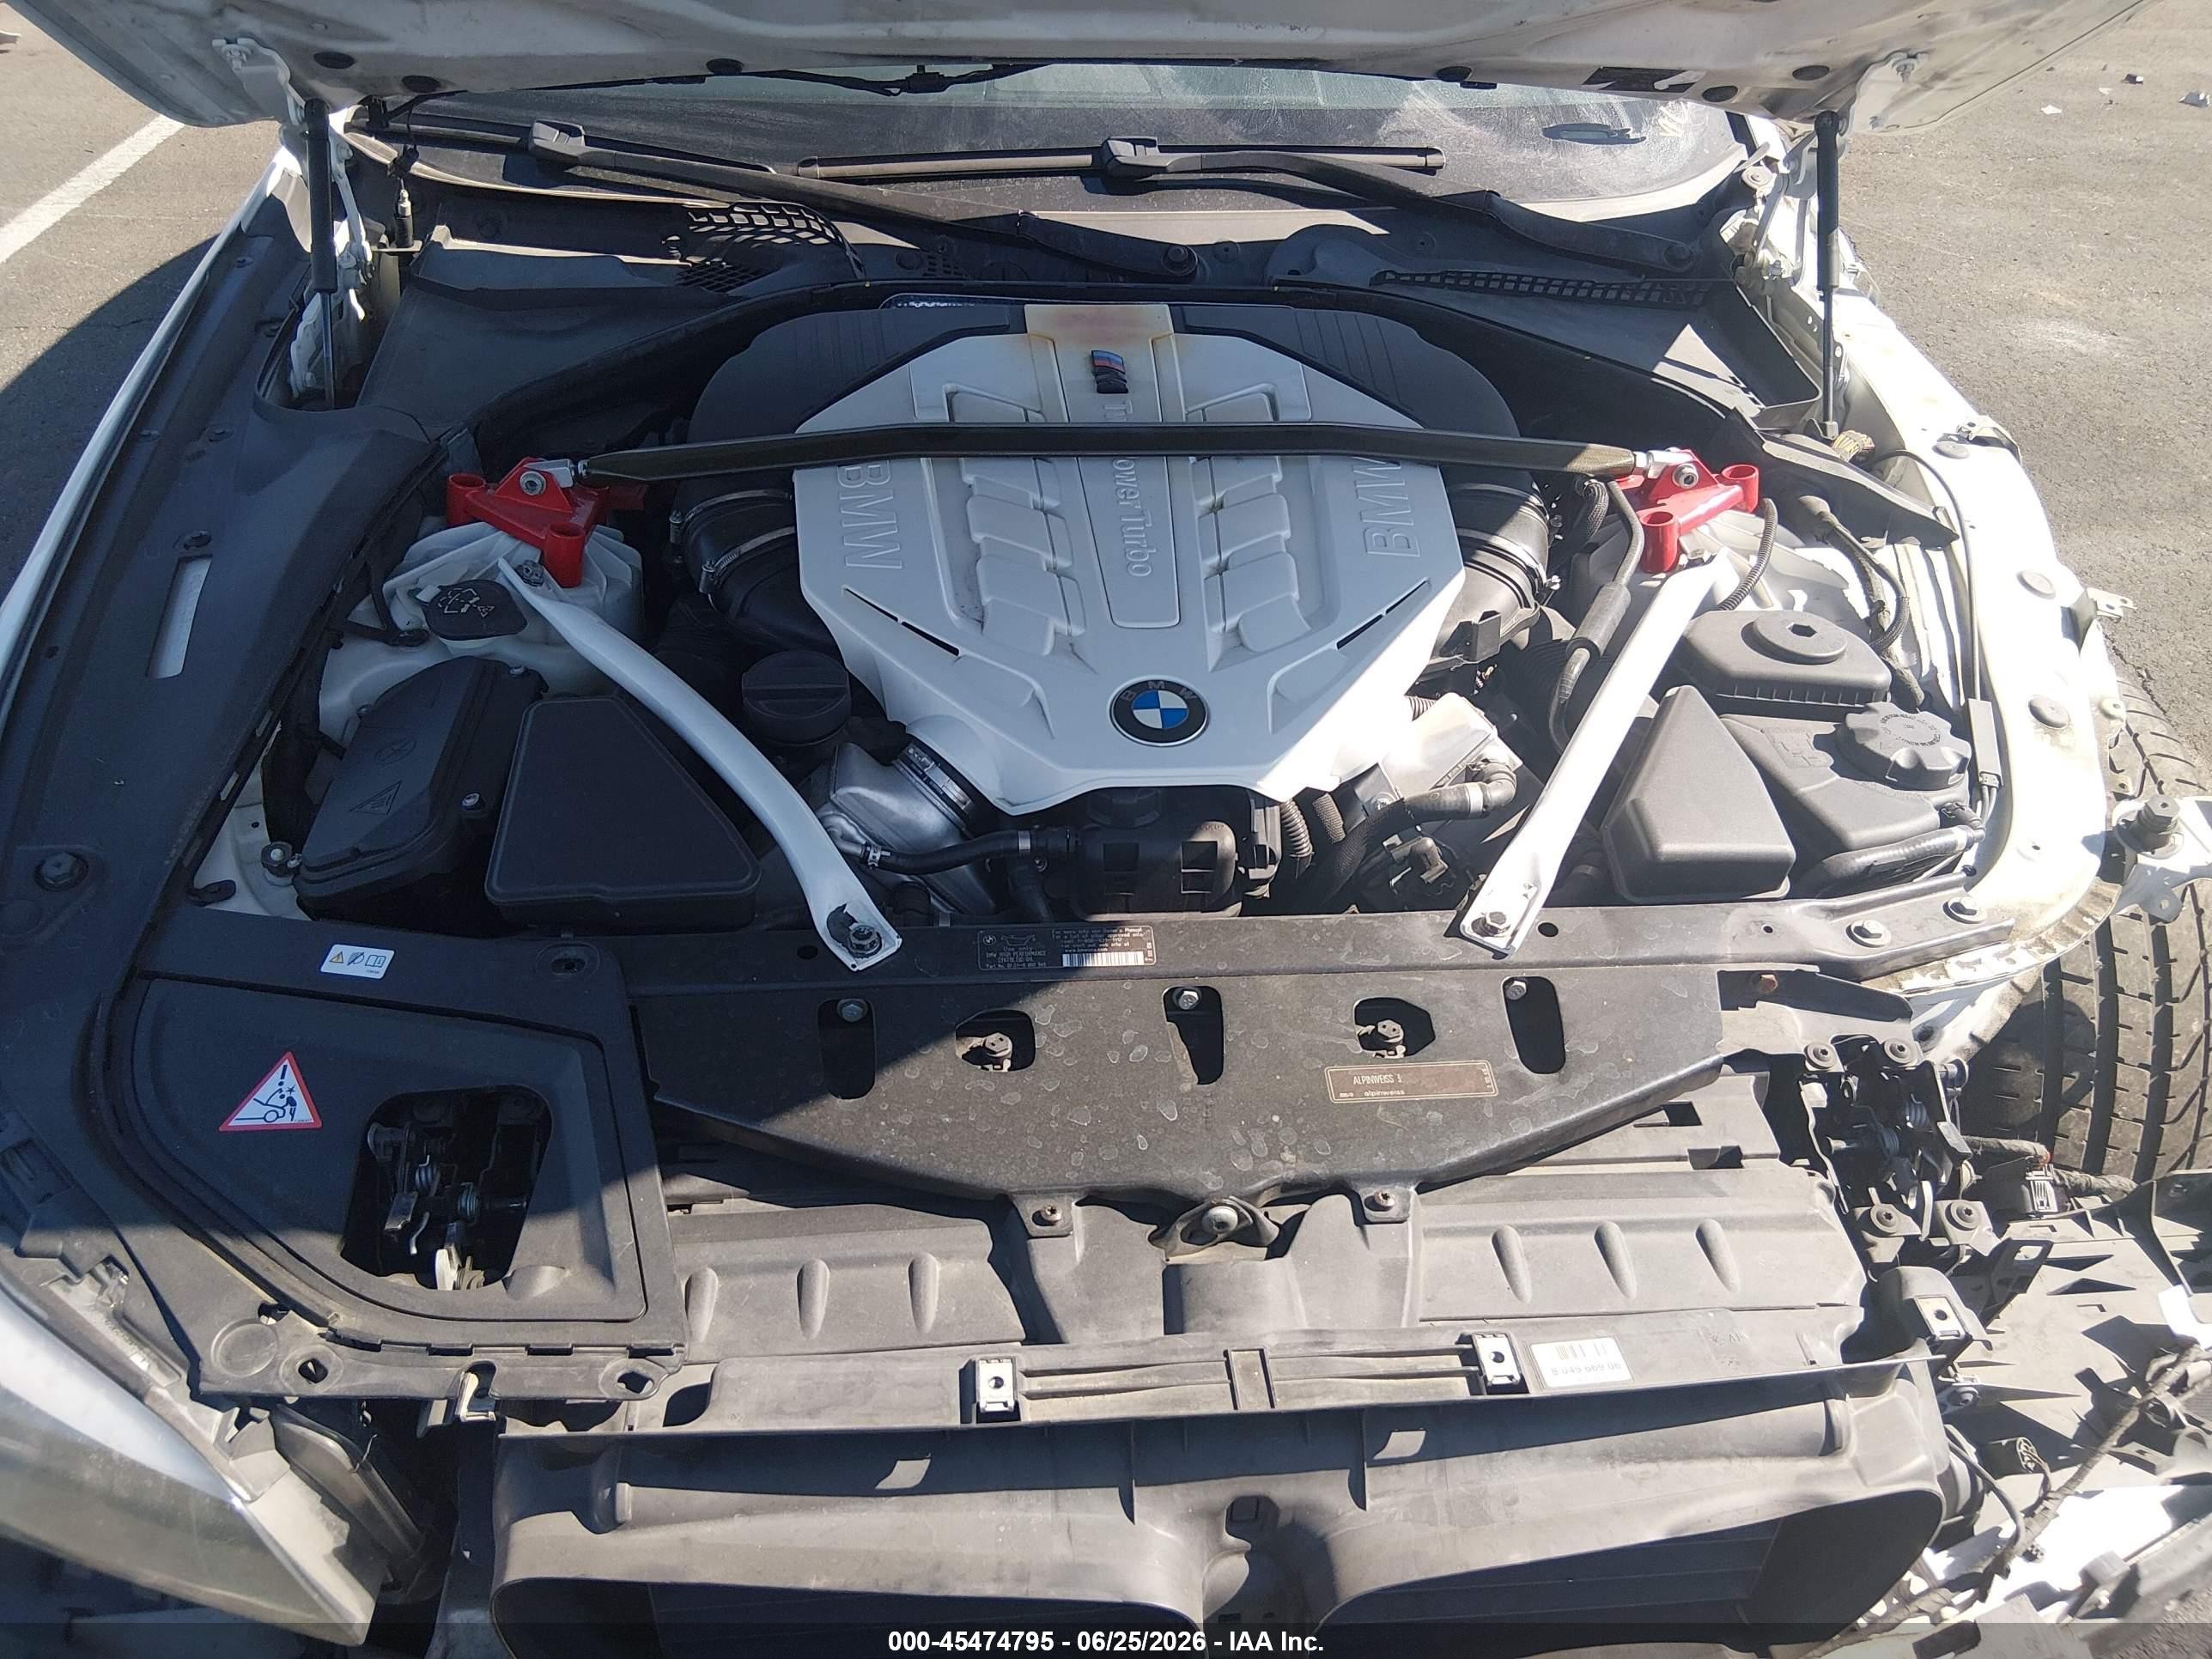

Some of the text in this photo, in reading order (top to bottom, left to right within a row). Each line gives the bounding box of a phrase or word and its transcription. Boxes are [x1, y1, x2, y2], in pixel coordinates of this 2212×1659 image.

[837, 459, 902, 568] BMW
[1352, 456, 1420, 557] BMW
[1120, 509, 1157, 577] Turbo
[1353, 1074, 1395, 1085] ALPINWEISS
[1364, 1089, 1405, 1097] alpinweiss
